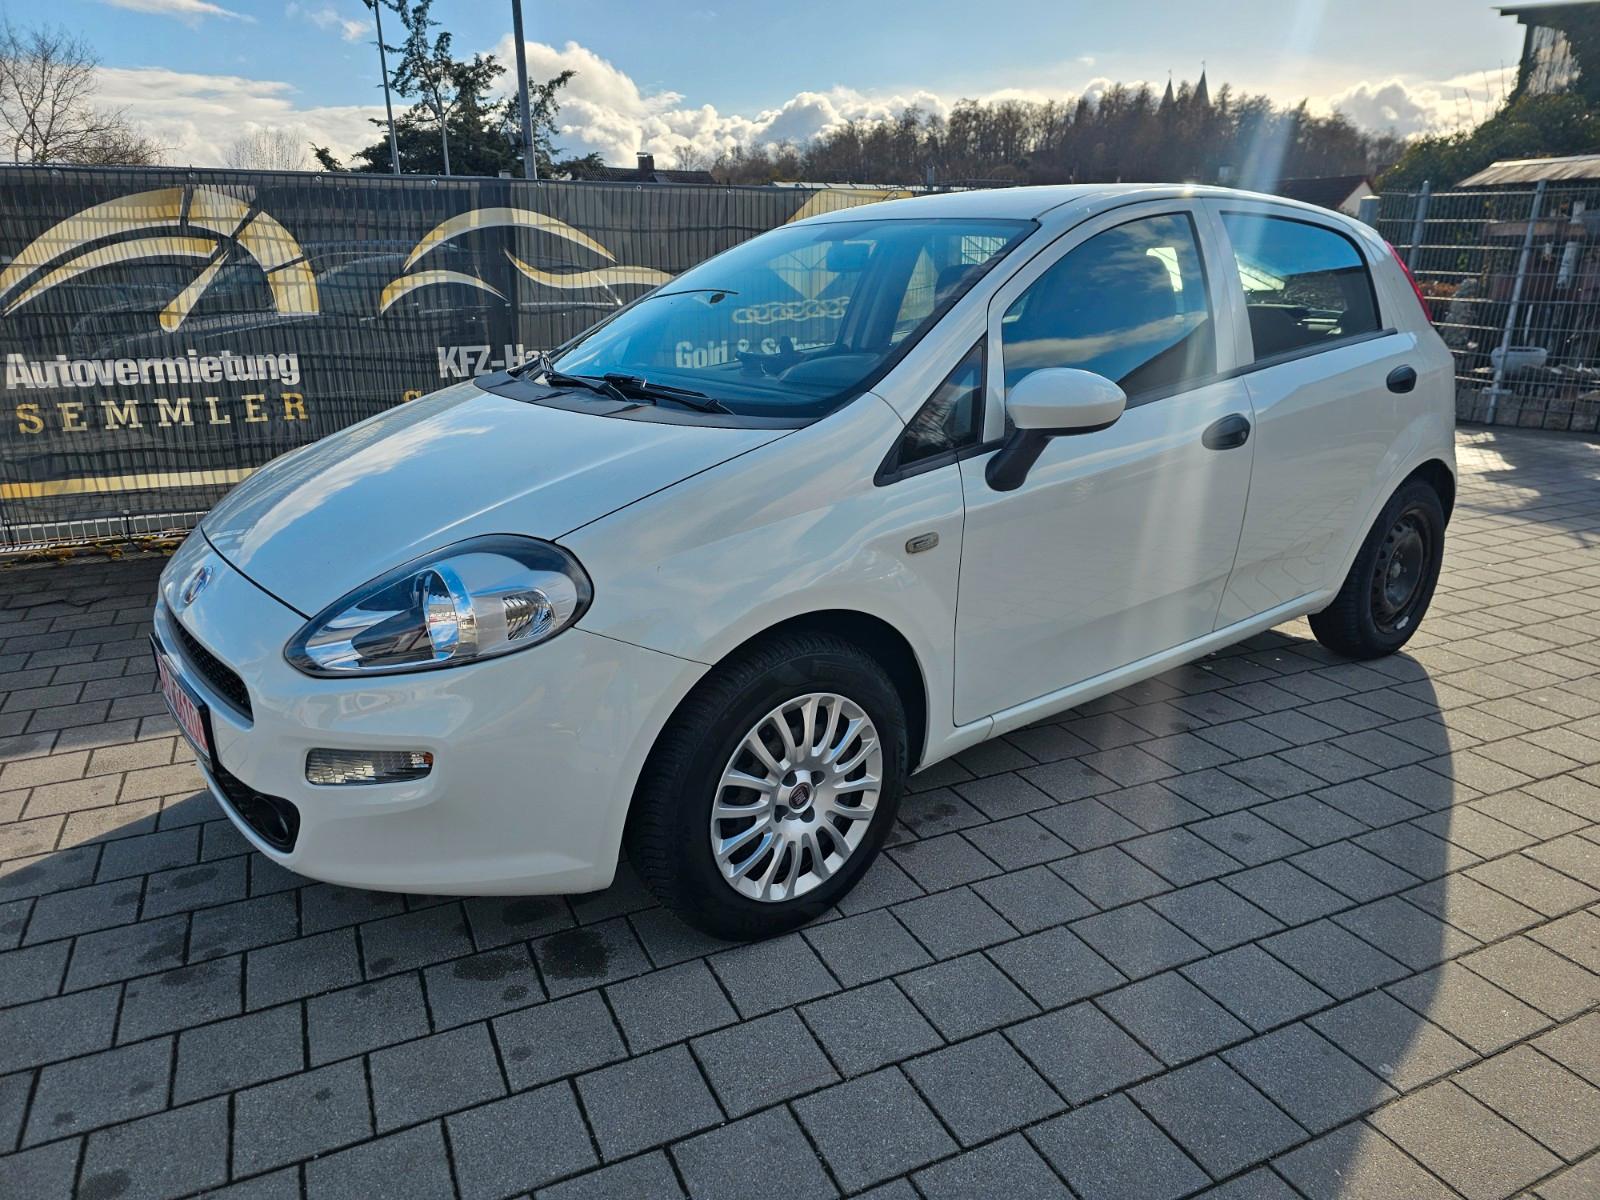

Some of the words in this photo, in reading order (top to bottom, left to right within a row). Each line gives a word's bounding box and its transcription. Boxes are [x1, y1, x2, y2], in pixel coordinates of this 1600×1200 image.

[6, 349, 301, 389] Autovermietung
[675, 340, 727, 368] Gold
[16, 392, 309, 434] SEMMLER
